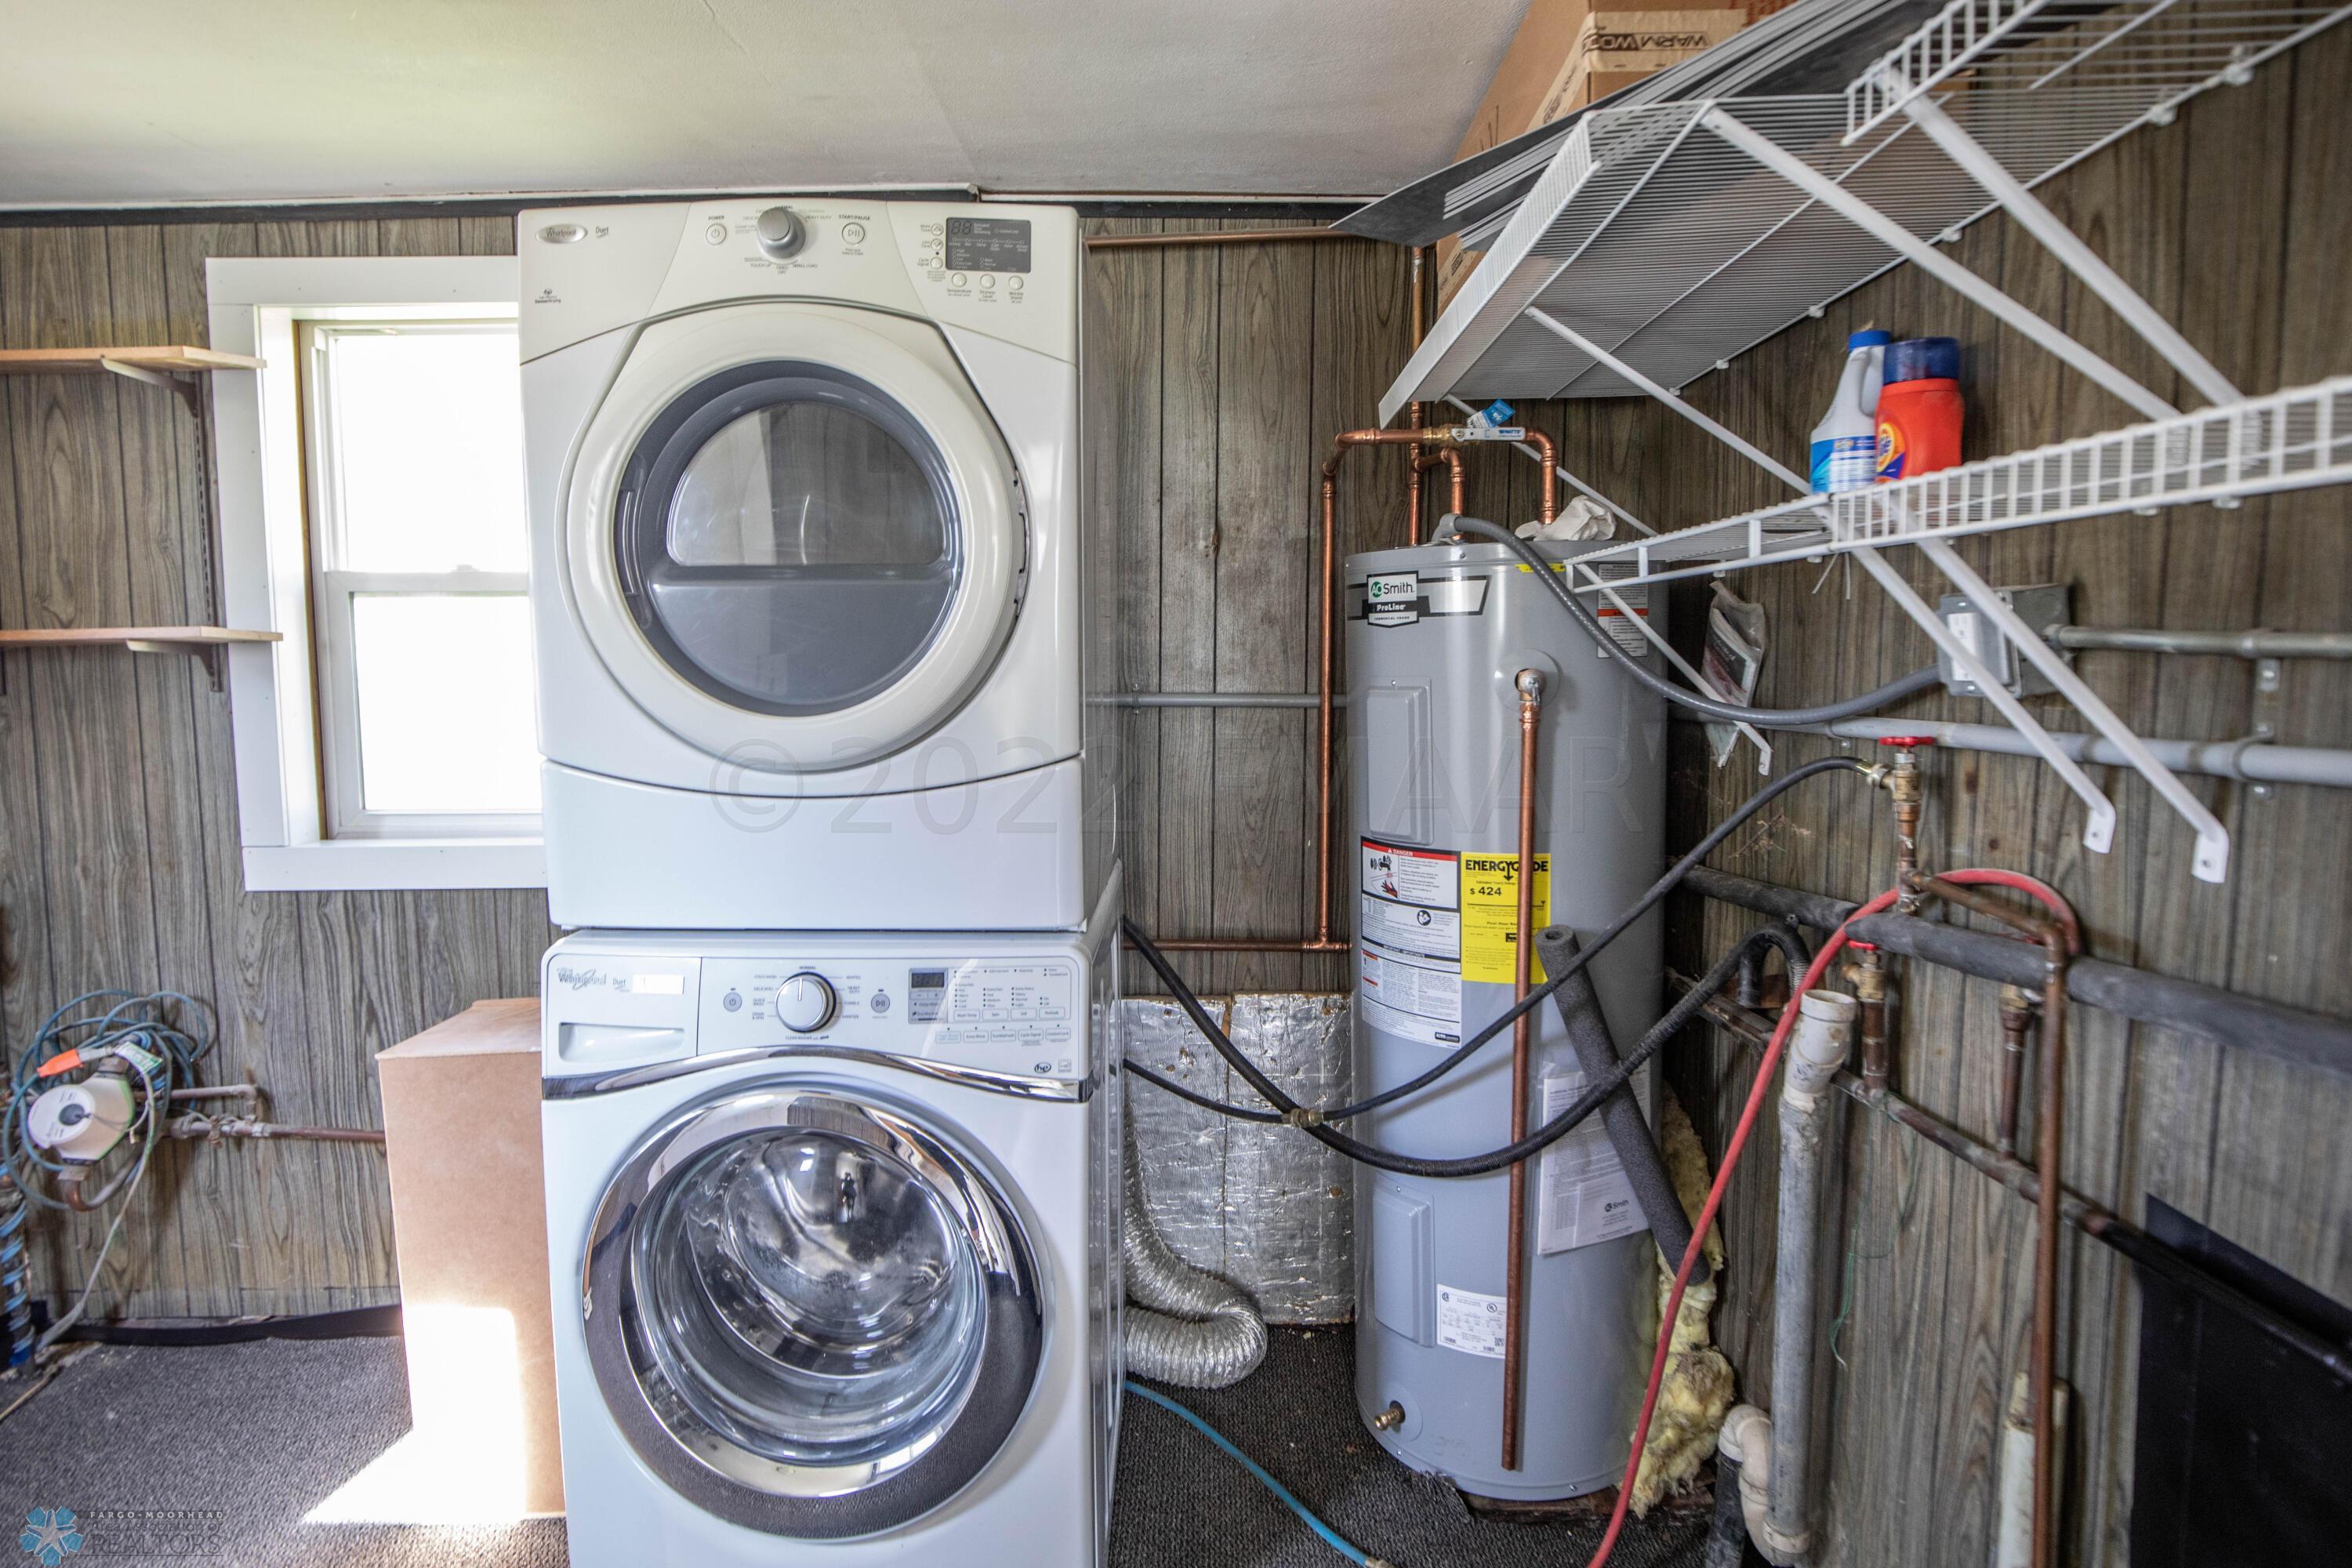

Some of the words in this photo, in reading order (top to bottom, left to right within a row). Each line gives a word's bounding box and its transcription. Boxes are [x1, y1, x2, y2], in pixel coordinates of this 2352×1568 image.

[546, 227, 576, 238] Whirlpool
[596, 226, 609, 234] Duet
[1383, 582, 1414, 595] Smith
[1478, 886, 1502, 896] 424
